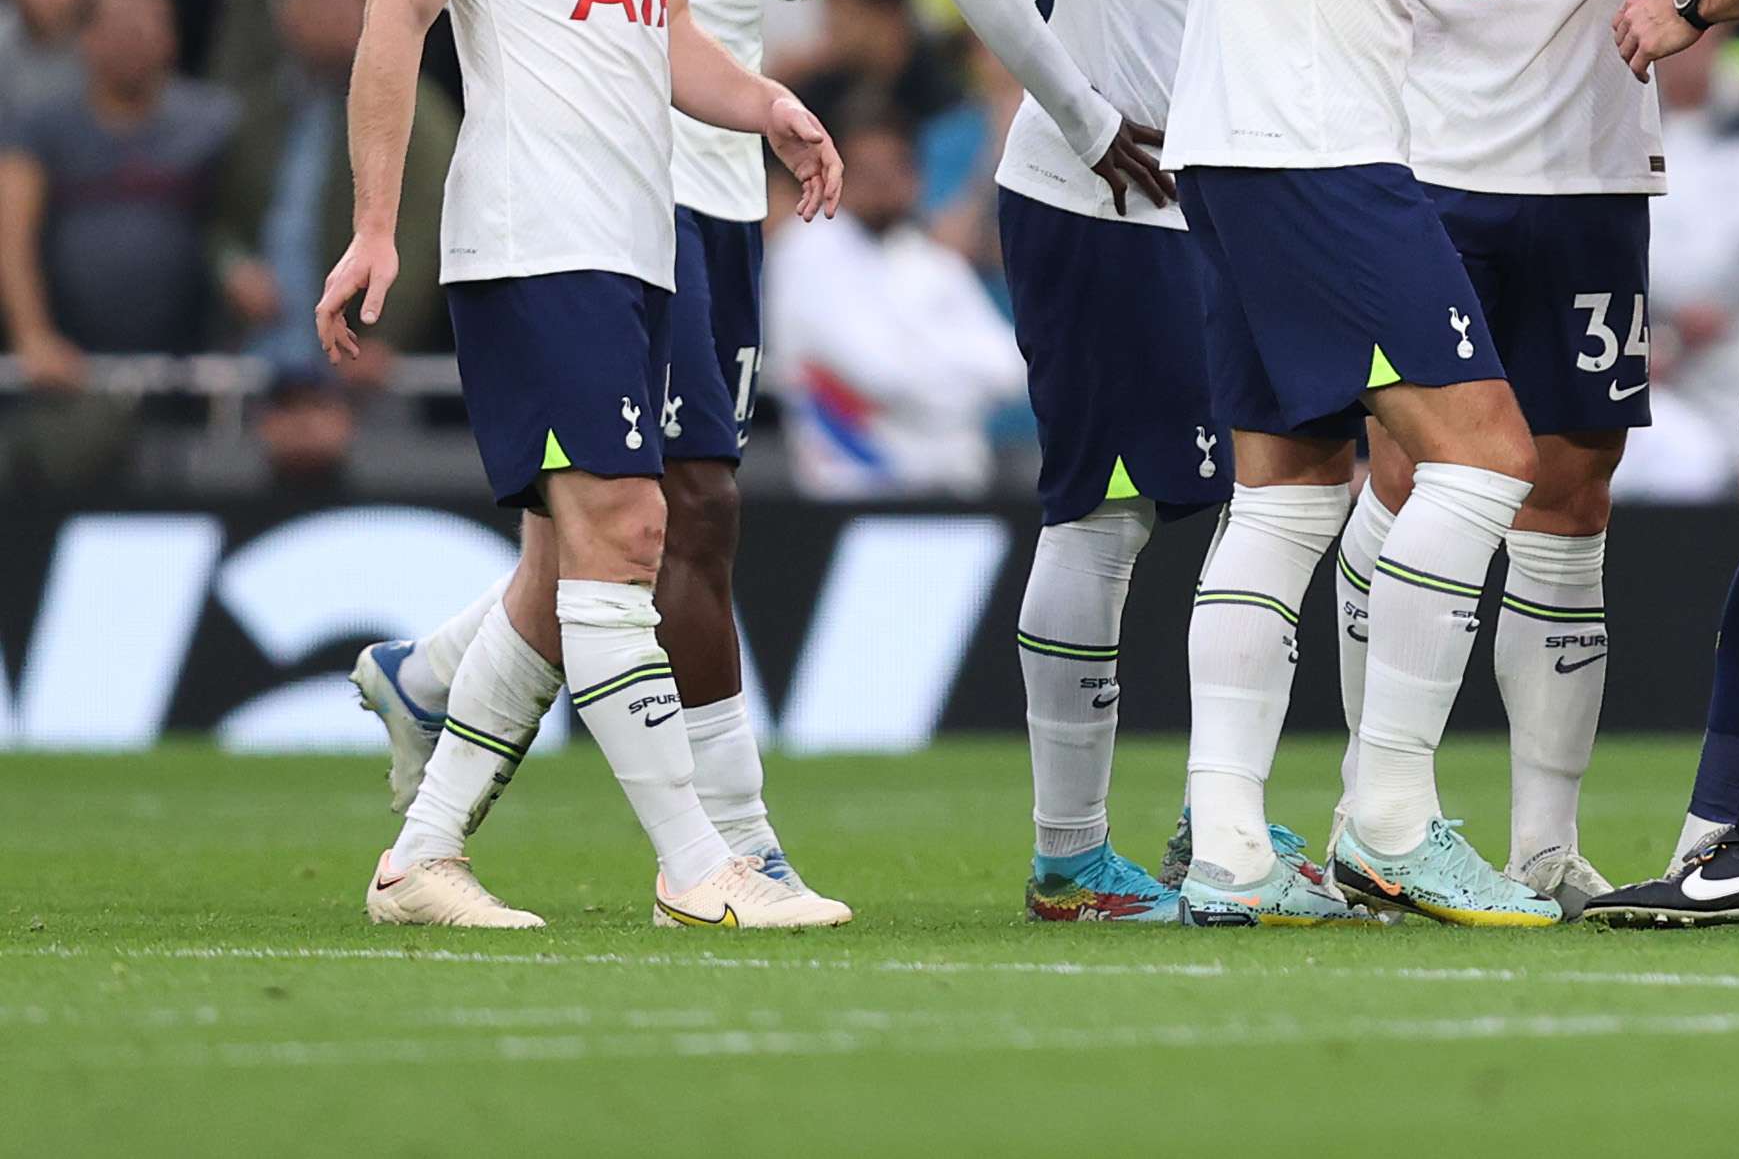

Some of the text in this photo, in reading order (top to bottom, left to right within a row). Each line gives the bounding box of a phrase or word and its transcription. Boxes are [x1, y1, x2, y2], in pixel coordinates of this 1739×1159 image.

[1573, 292, 1650, 374] 34
[1545, 635, 1607, 648] SPUR
[1080, 677, 1117, 690] SPU
